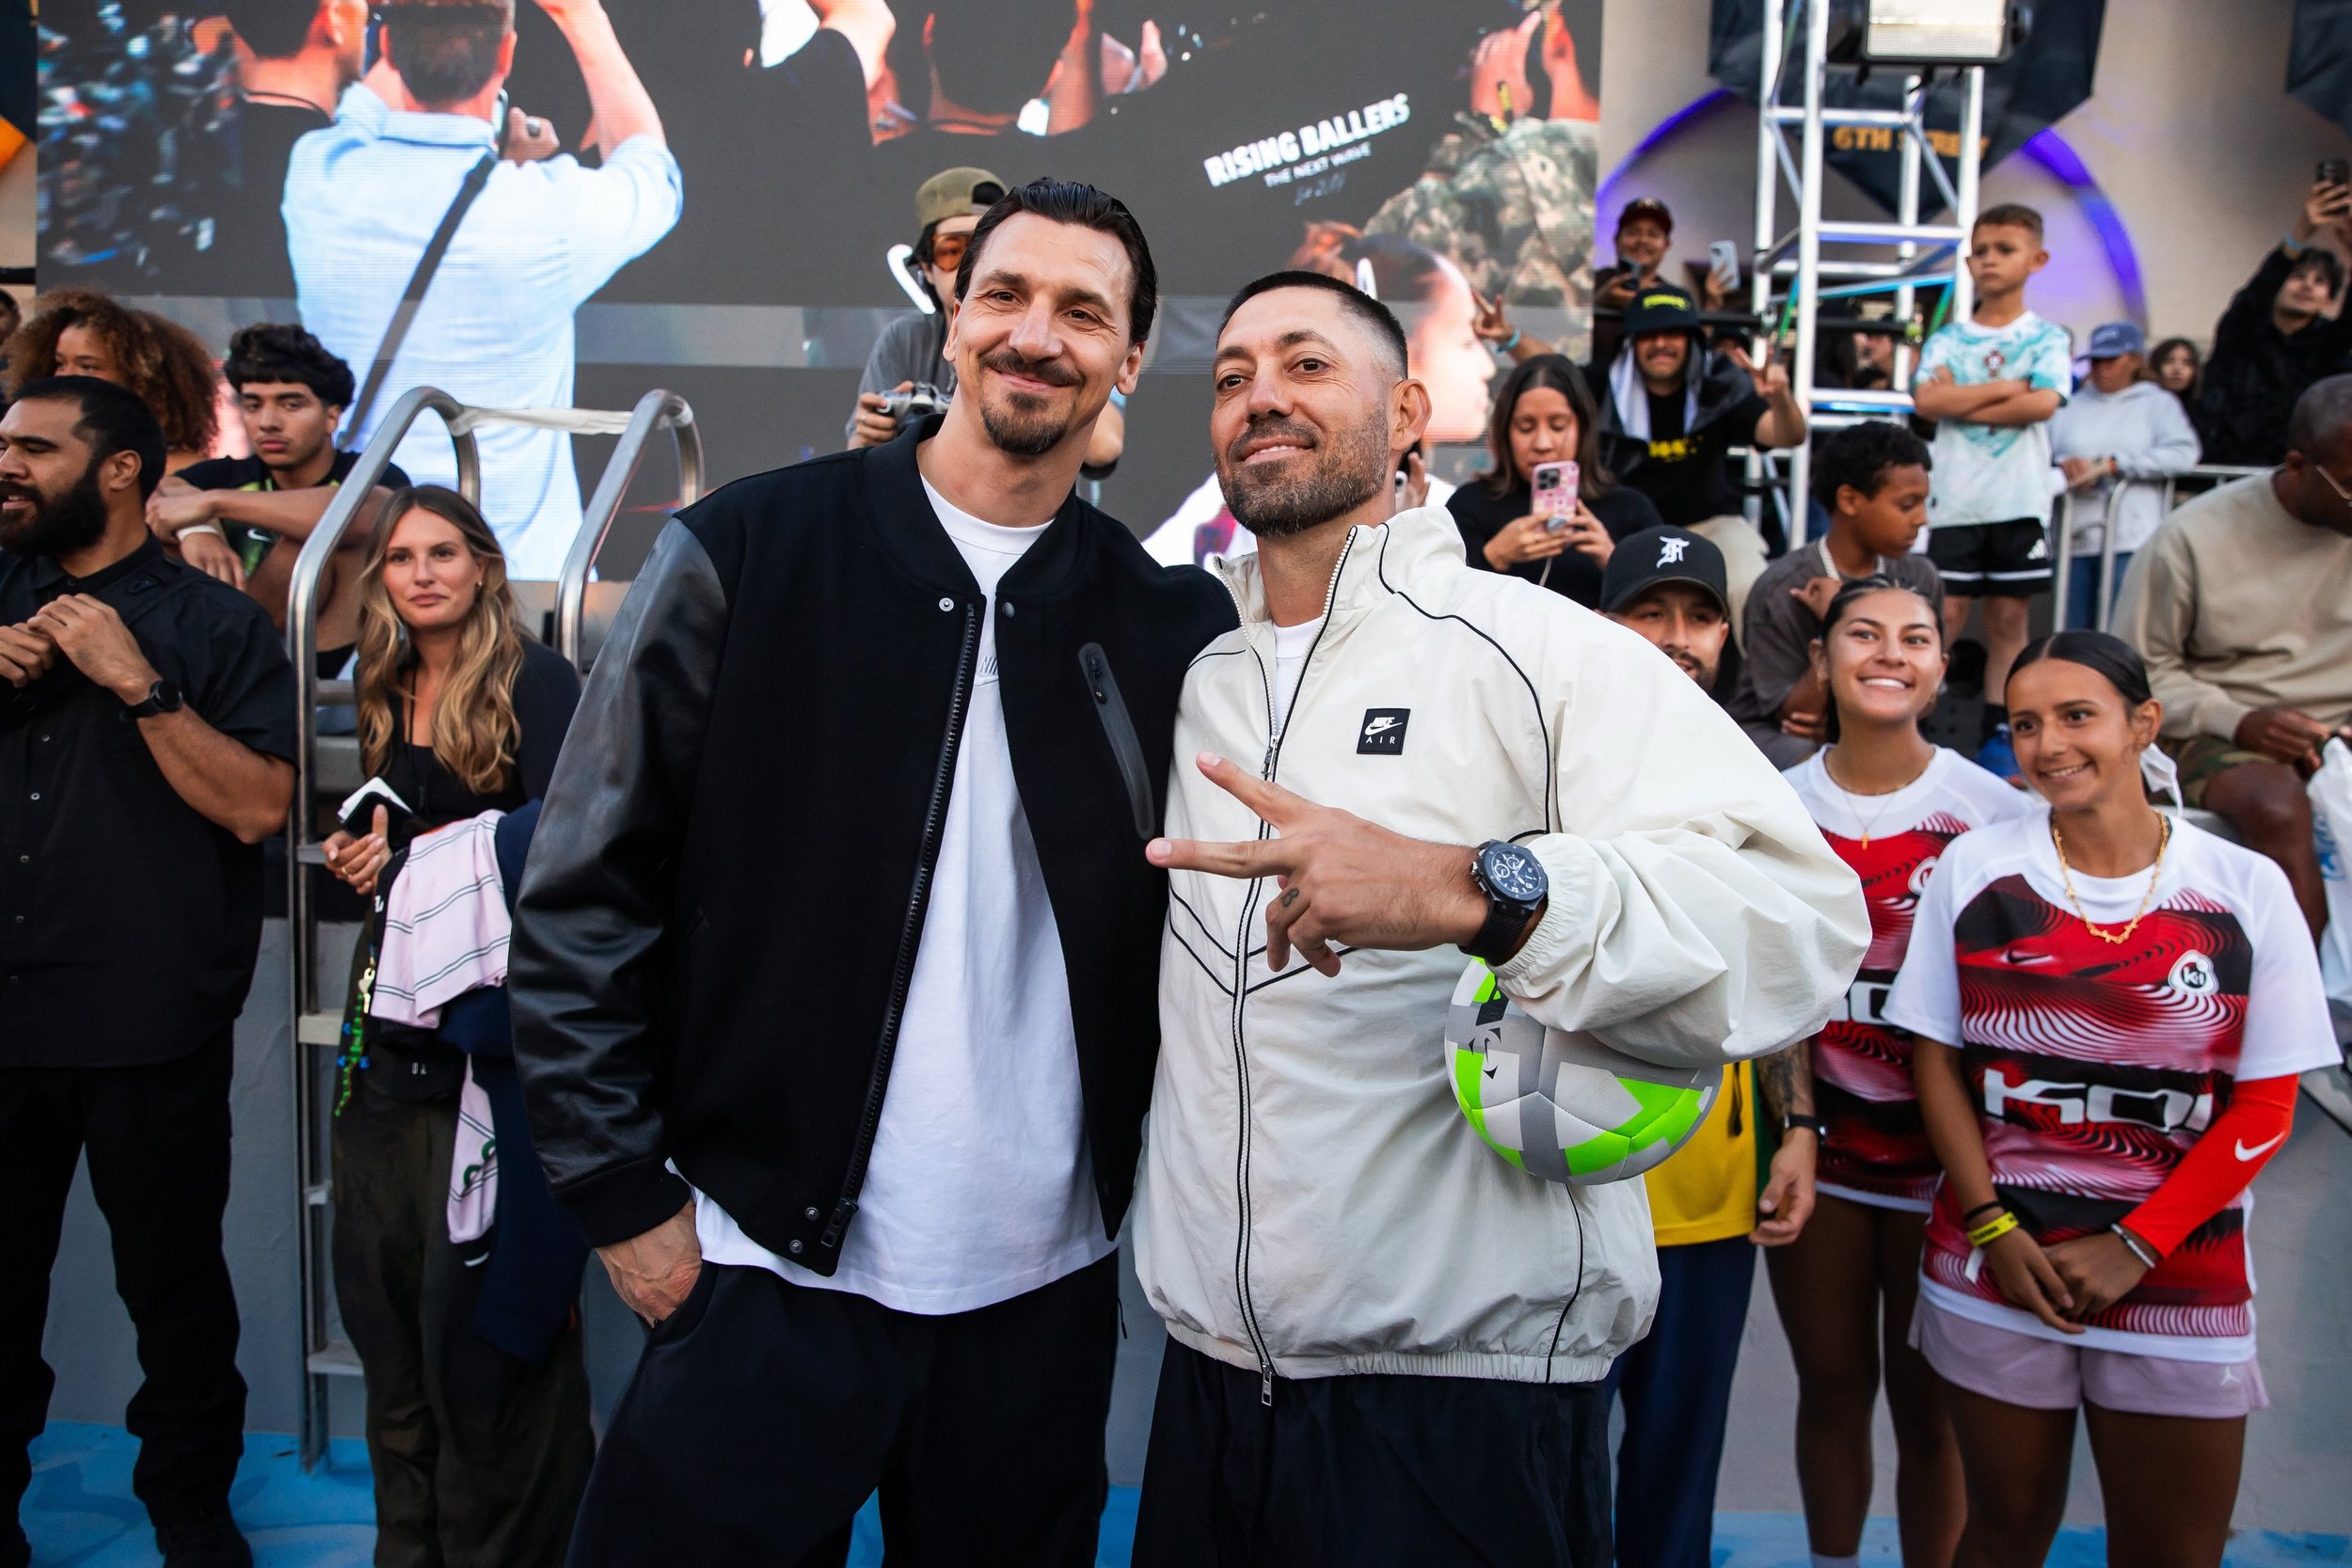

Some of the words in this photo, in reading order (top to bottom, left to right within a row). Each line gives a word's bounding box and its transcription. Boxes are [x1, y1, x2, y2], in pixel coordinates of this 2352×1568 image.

[1203, 131, 1300, 187] RISING
[1298, 92, 1410, 156] BALLERS
[1366, 736, 1395, 744] AIR
[1983, 1068, 2213, 1132] KOI
